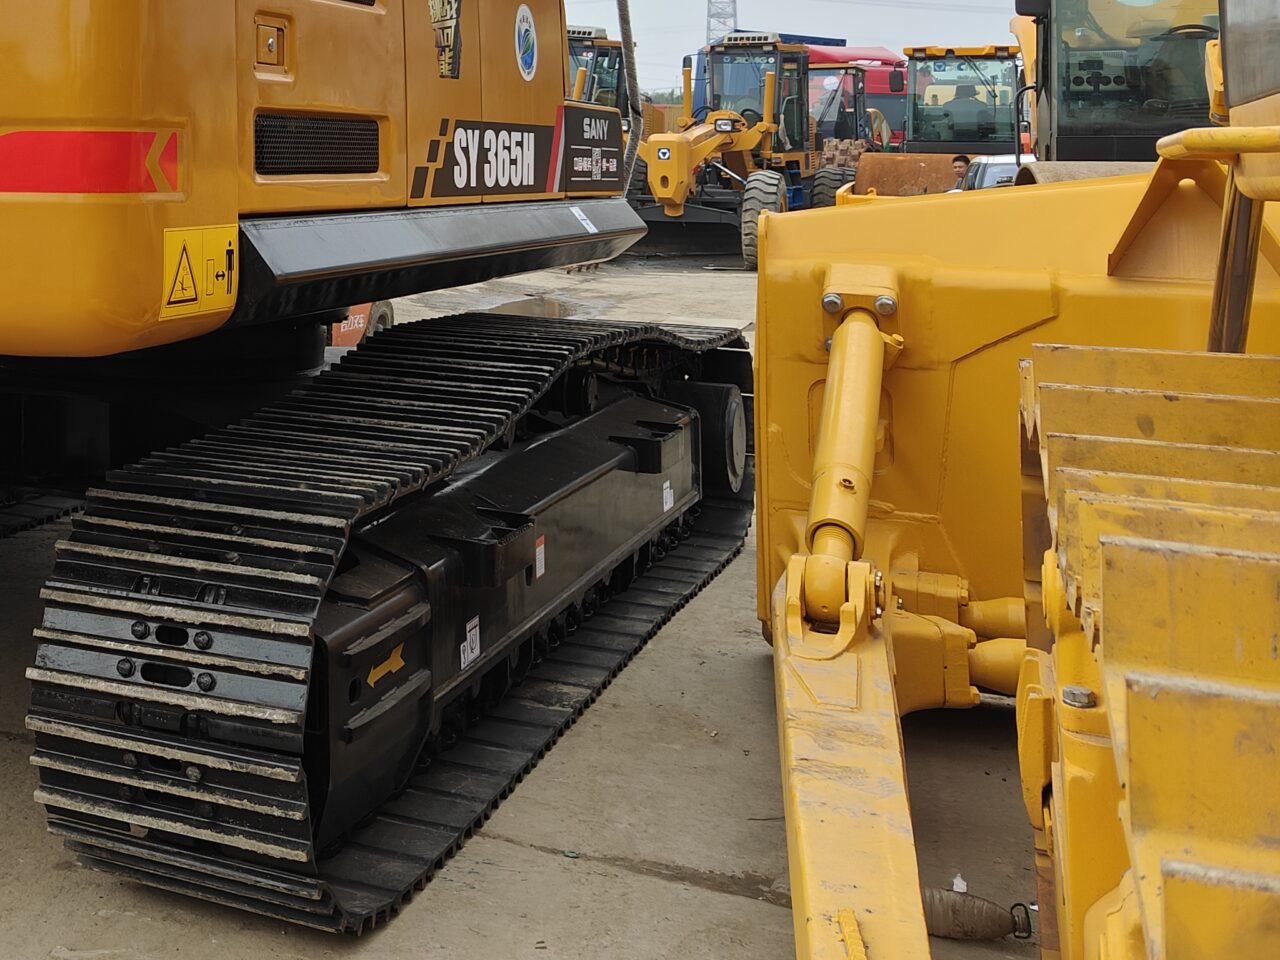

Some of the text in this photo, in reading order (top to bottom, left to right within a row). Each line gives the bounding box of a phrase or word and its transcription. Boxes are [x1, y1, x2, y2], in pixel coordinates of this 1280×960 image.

[583, 117, 609, 140] SANY
[453, 127, 535, 189] SY 365H
